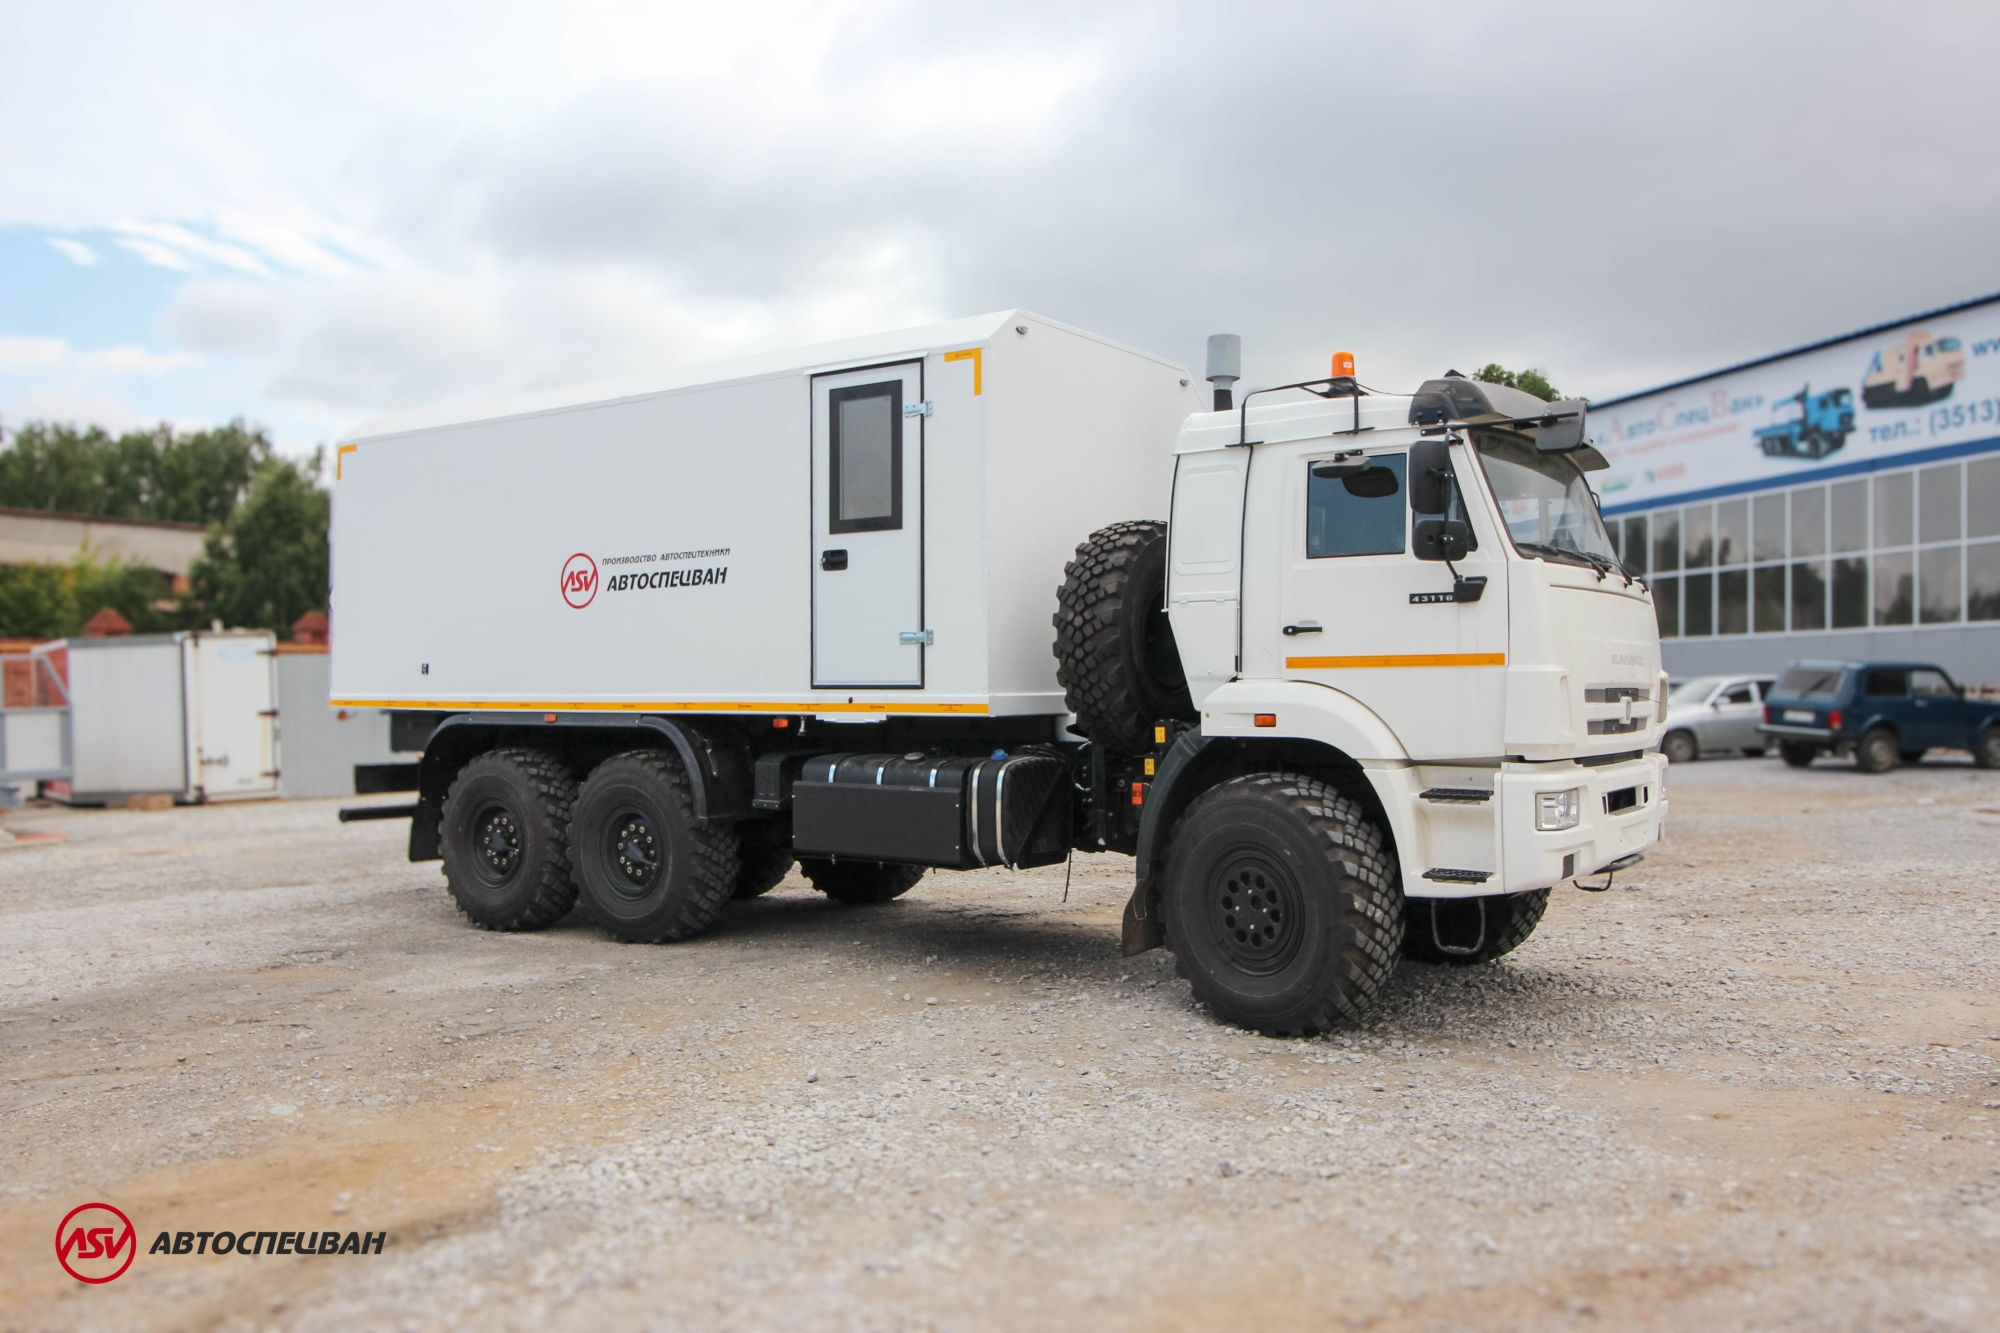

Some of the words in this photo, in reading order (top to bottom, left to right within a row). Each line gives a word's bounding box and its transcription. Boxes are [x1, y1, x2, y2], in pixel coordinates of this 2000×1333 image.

[602, 554, 657, 566] ПРОИЗВОДСТВО
[660, 548, 731, 561] АВТОСПЕЦТЕХНИКИ
[606, 567, 728, 592] АВТОСПЕЦВАН
[1412, 595, 1453, 603] 43118
